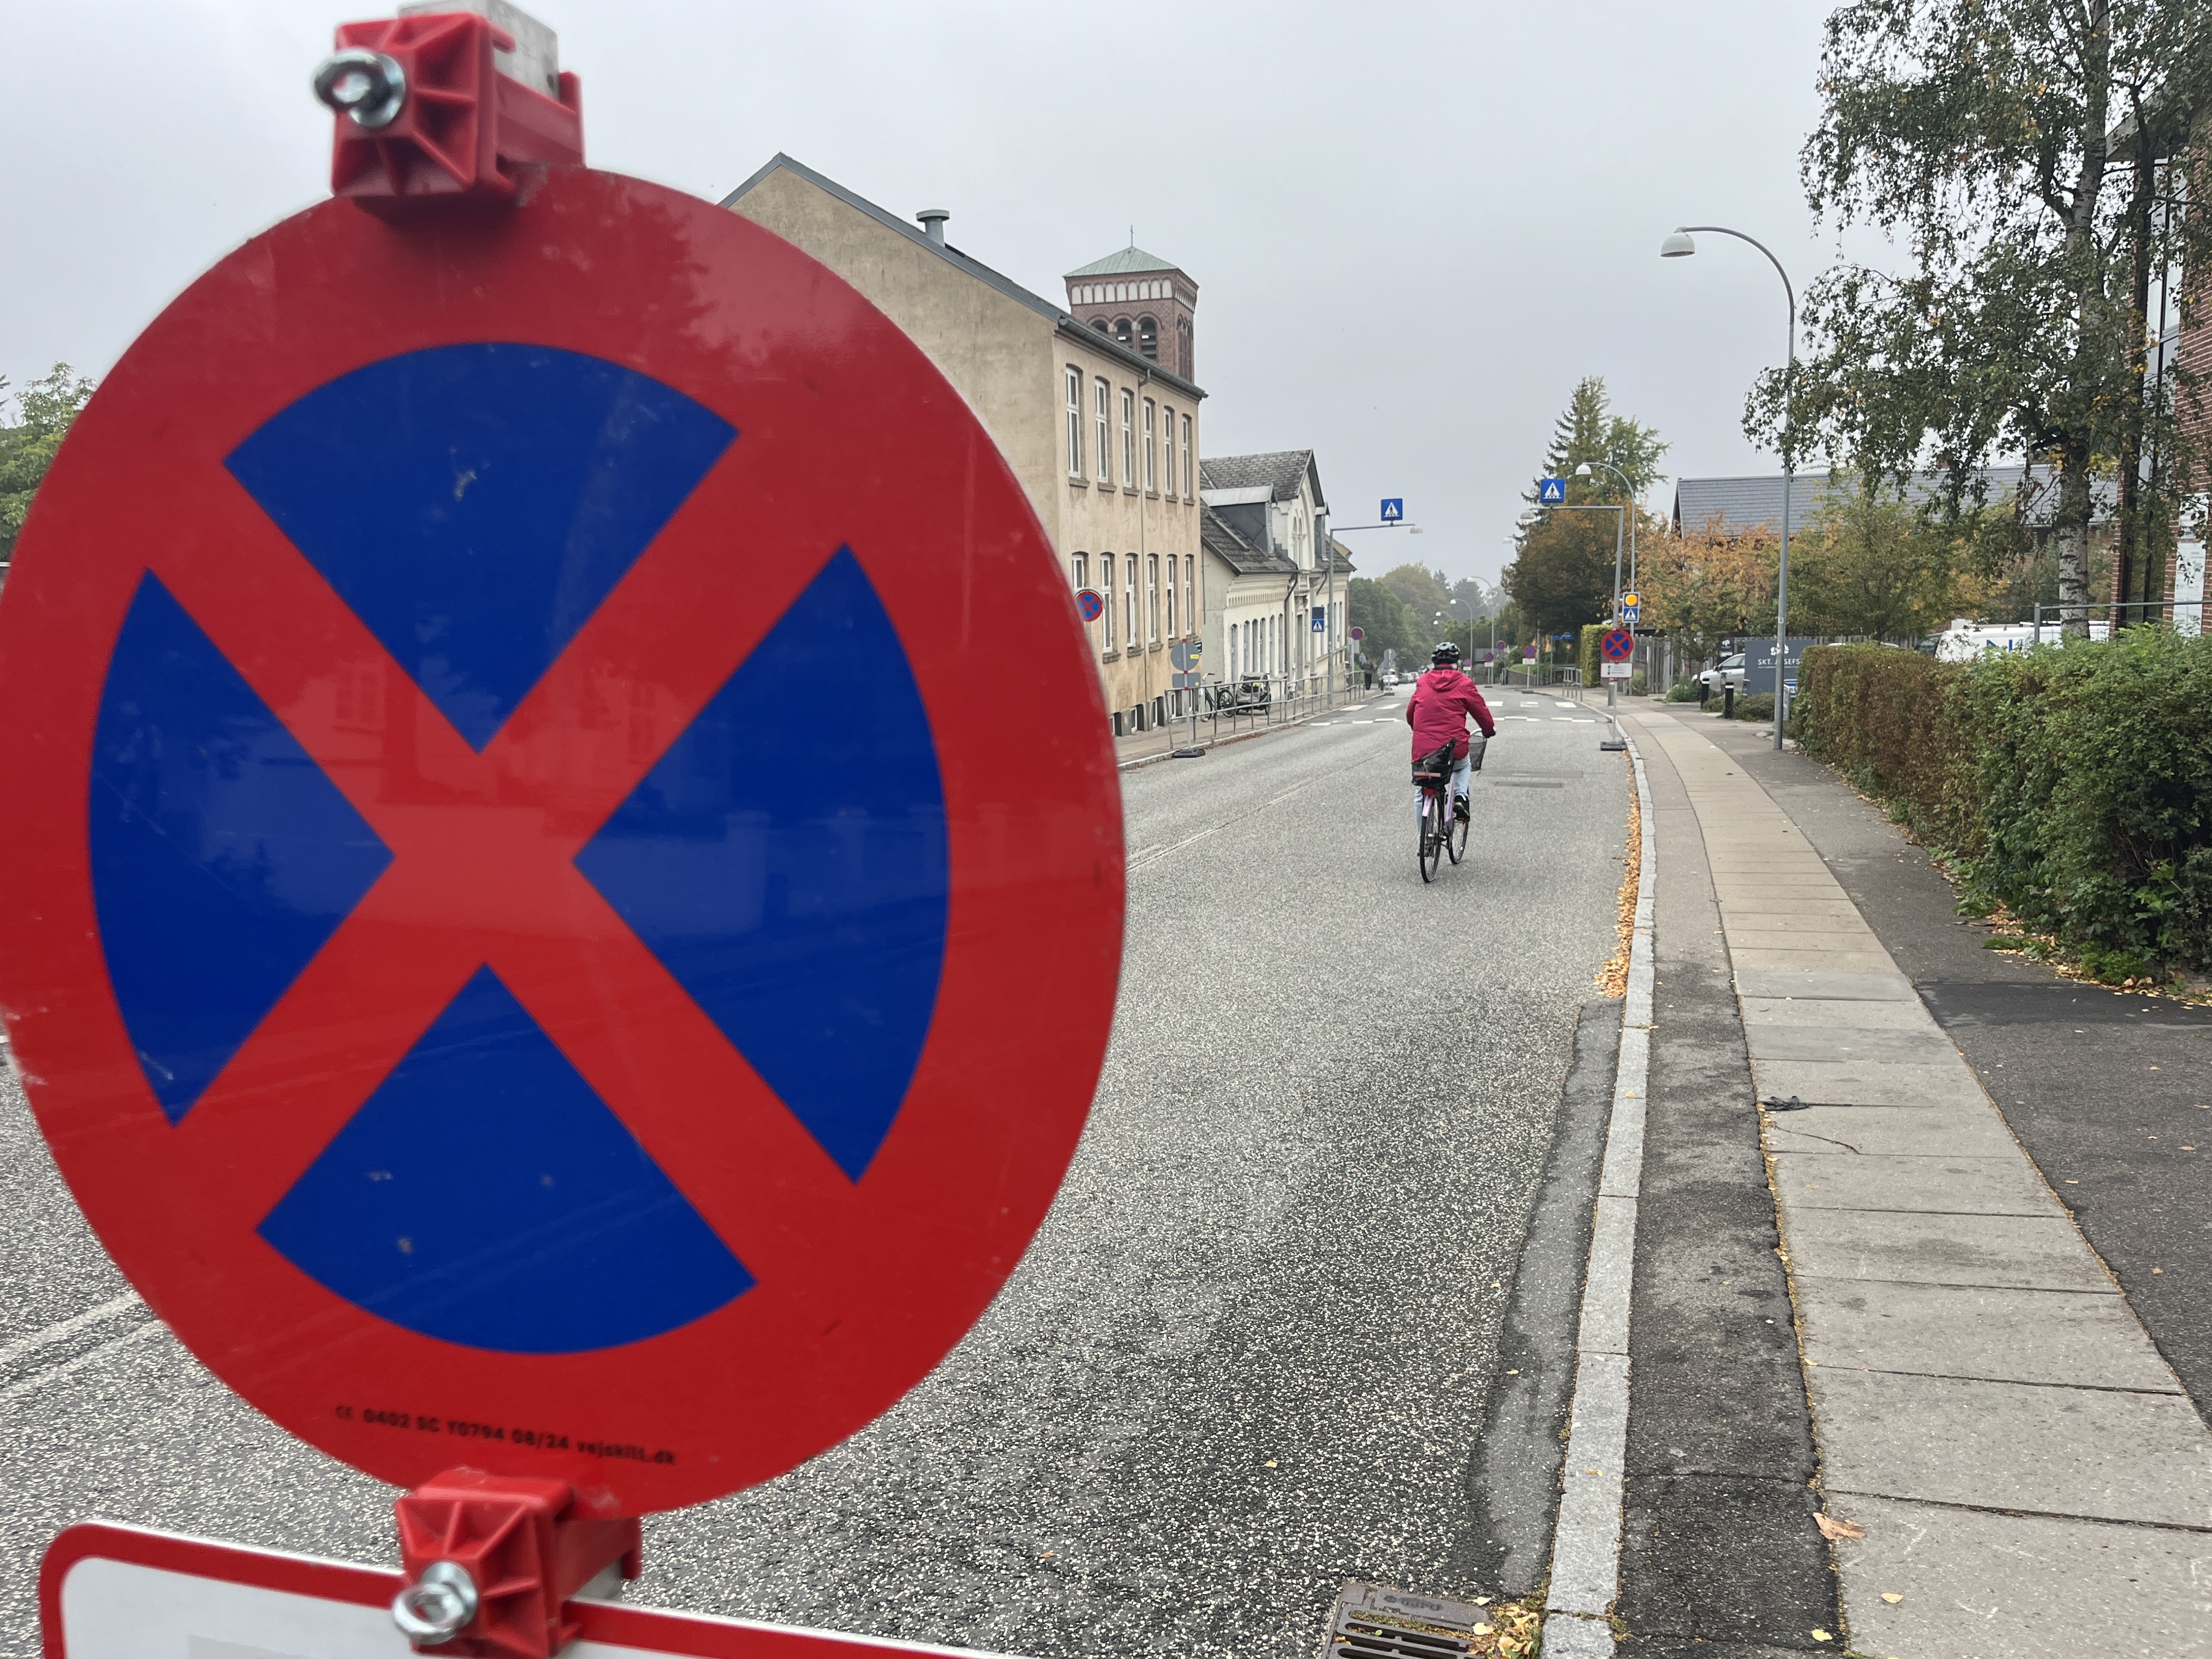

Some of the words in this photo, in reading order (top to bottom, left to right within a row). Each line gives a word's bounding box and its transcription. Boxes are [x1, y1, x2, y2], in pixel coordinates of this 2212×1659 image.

[364, 1408, 410, 1429] 0402
[417, 1415, 441, 1432] SC
[511, 1429, 569, 1449] 08/24
[577, 1442, 676, 1465] vejskilt.dk
